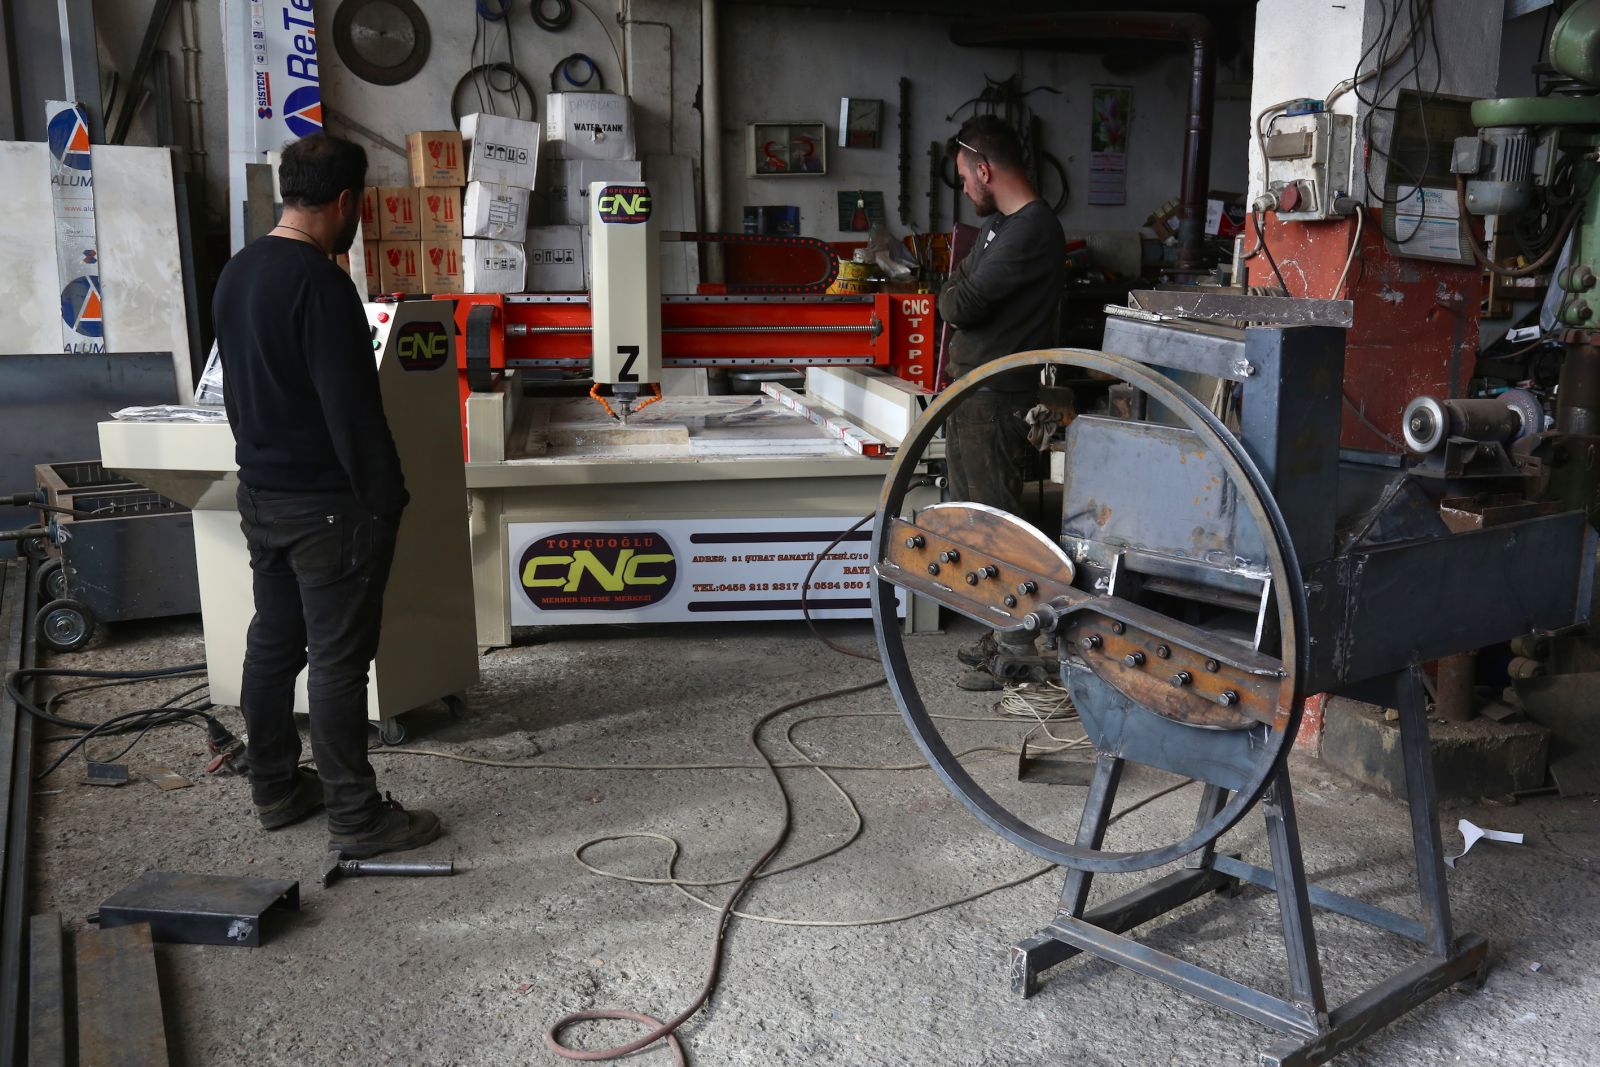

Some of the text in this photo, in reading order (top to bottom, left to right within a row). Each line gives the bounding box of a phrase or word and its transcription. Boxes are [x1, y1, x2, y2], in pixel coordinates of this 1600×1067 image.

[602, 124, 623, 132] TANK
[599, 194, 650, 215] CNC
[902, 299, 930, 315] CNC
[398, 332, 447, 359] CNC
[617, 345, 640, 382] Z
[731, 555, 743, 563] 21
[522, 549, 675, 592] CNC
